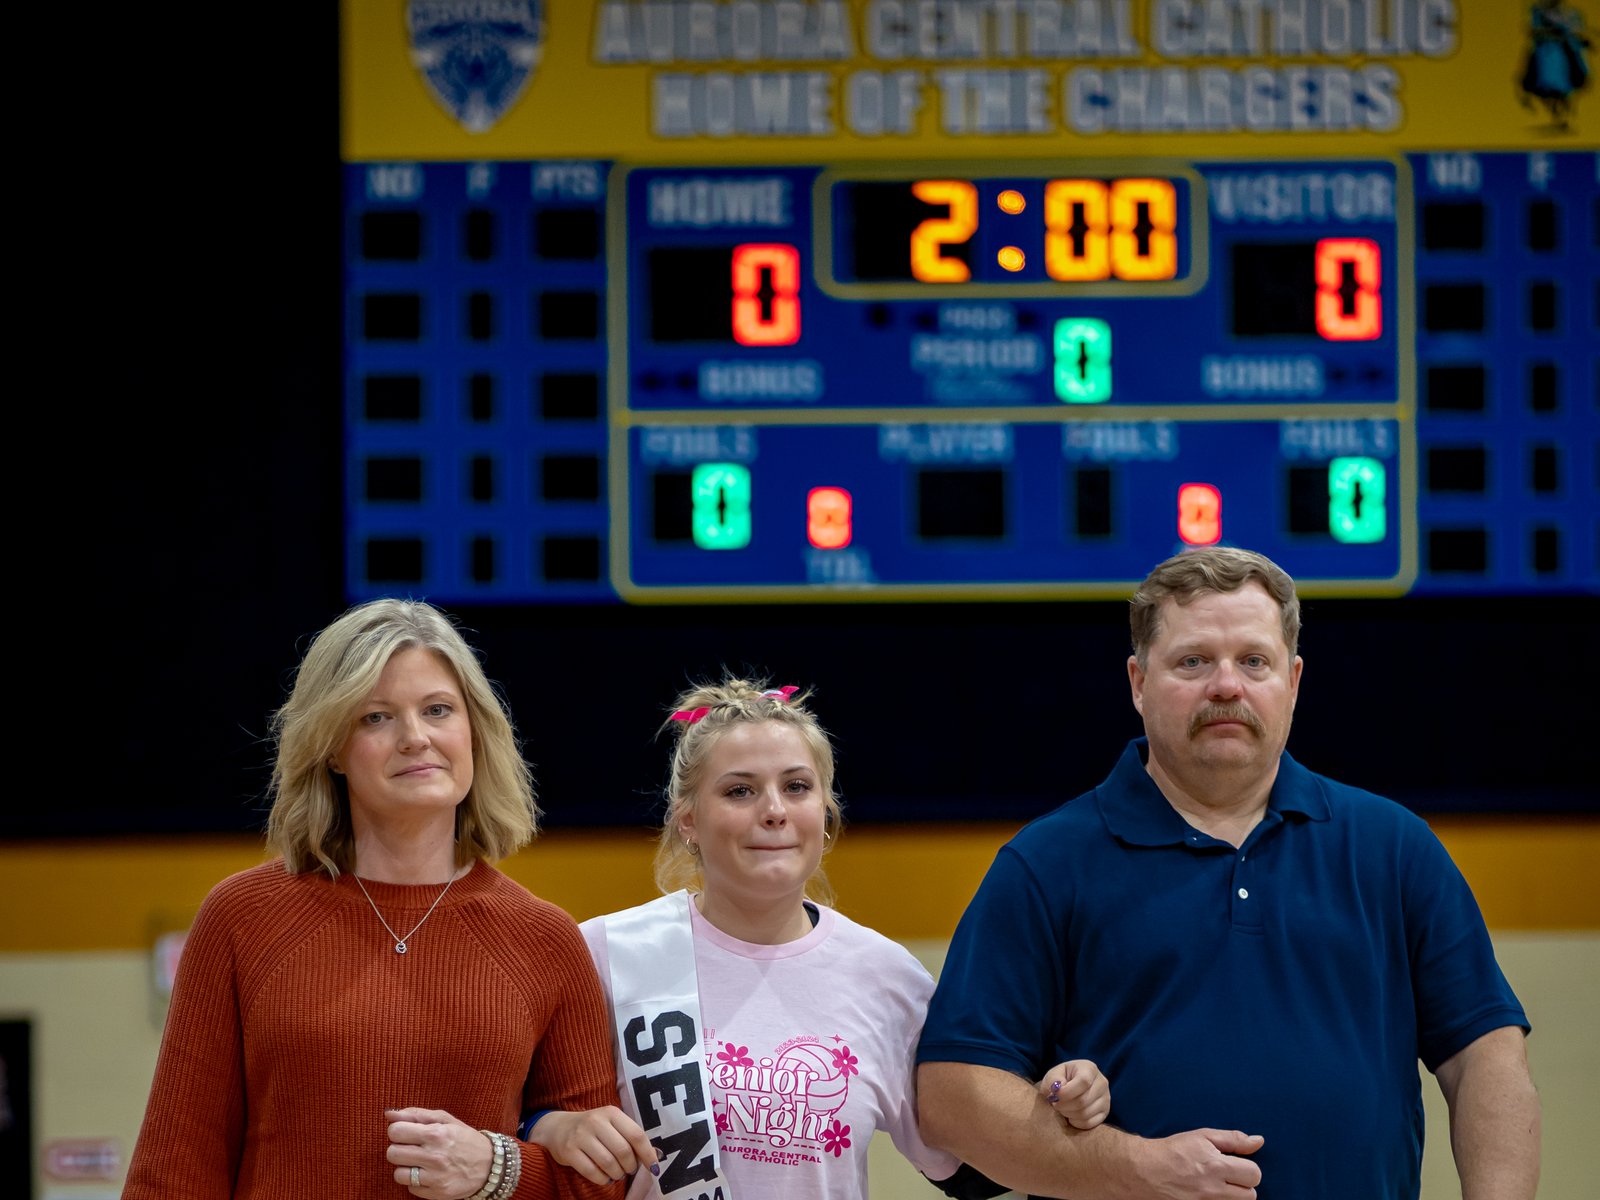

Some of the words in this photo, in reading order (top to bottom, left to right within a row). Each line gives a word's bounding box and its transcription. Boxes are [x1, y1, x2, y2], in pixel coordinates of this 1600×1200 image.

[596, 0, 853, 62] AURORA
[868, 0, 1140, 60] CENTRAL
[1154, 0, 1458, 58] CATHOLIC
[652, 70, 835, 136] HOME
[845, 70, 921, 135] OF
[936, 68, 1053, 134] THE
[1064, 65, 1401, 133] CHARGERS
[648, 178, 790, 227] HOME
[1209, 170, 1396, 222] VISITOR
[911, 178, 1177, 283] 2:00
[732, 242, 801, 347] 0
[1315, 237, 1382, 341] 0
[1053, 317, 1112, 403] 0
[692, 462, 752, 550] 0
[1328, 457, 1386, 543] 0
[706, 1054, 820, 1096] enior
[726, 1093, 834, 1148] Night
[721, 1144, 768, 1157] AURORA
[771, 1150, 822, 1164] CENTRAL
[742, 1153, 800, 1166] CATHOLIC
